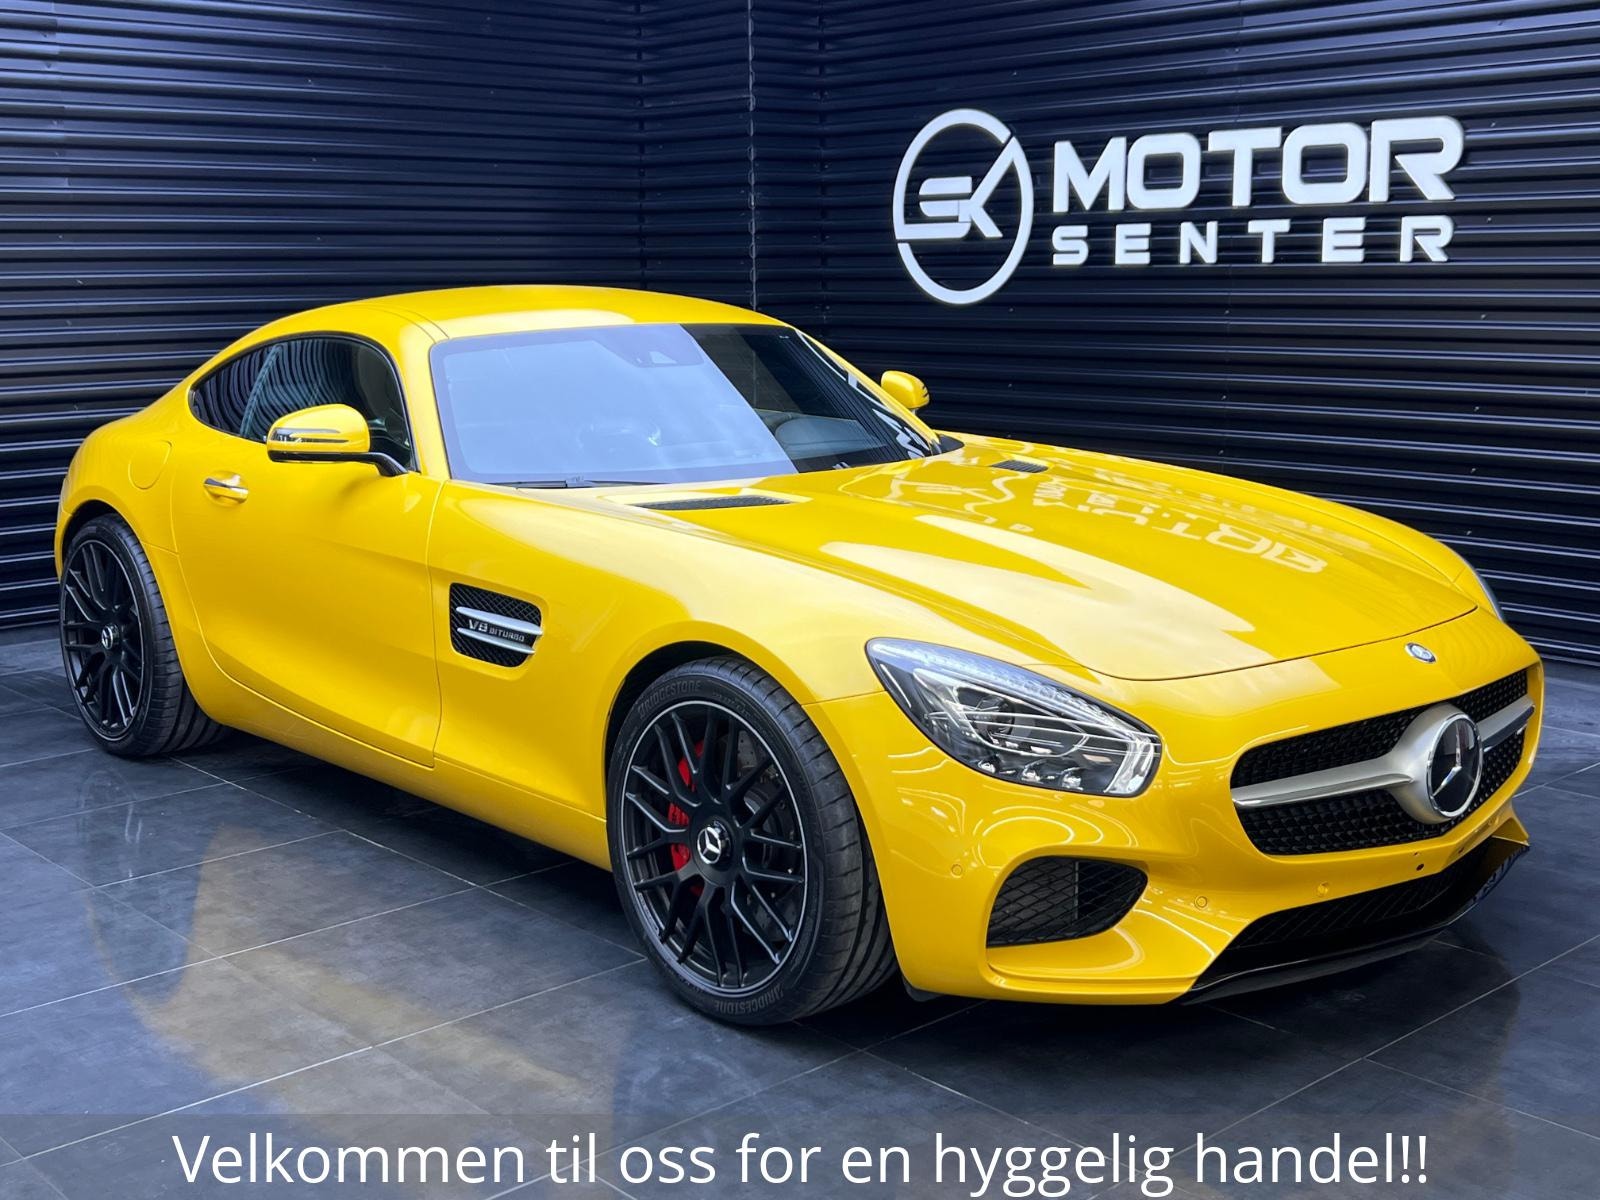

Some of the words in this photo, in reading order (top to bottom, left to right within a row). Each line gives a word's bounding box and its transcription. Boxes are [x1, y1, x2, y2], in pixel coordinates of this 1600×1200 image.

[1052, 115, 1465, 213] MOTOR
[1052, 214, 1455, 266] SENTER
[468, 619, 488, 633] V8
